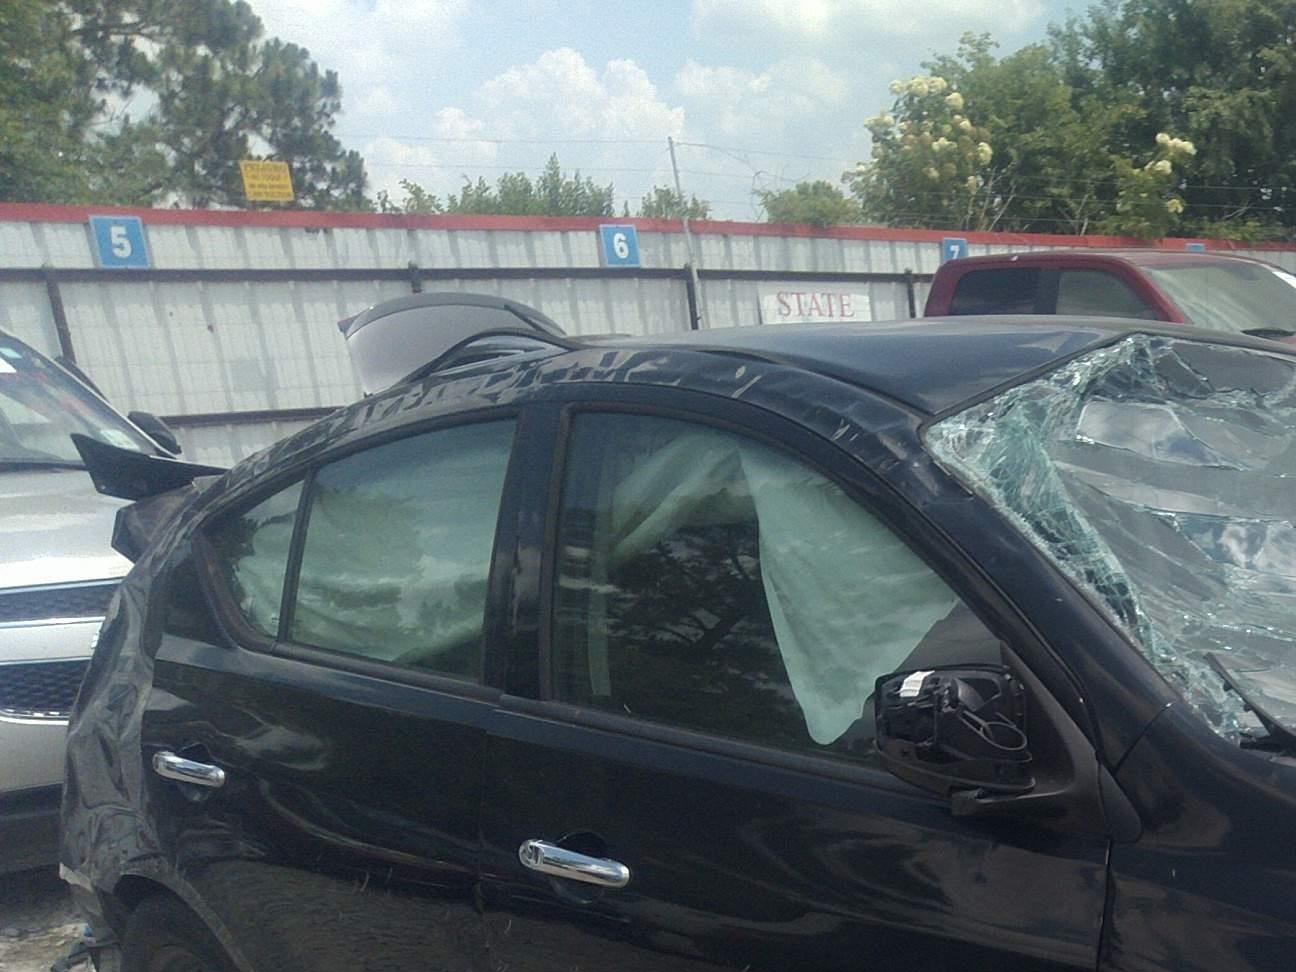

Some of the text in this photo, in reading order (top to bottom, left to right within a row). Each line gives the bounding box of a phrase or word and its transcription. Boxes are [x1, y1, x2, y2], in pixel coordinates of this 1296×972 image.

[110, 226, 133, 259] 5
[612, 233, 630, 258] 6
[949, 244, 961, 260] 7
[775, 290, 855, 318] STATE
